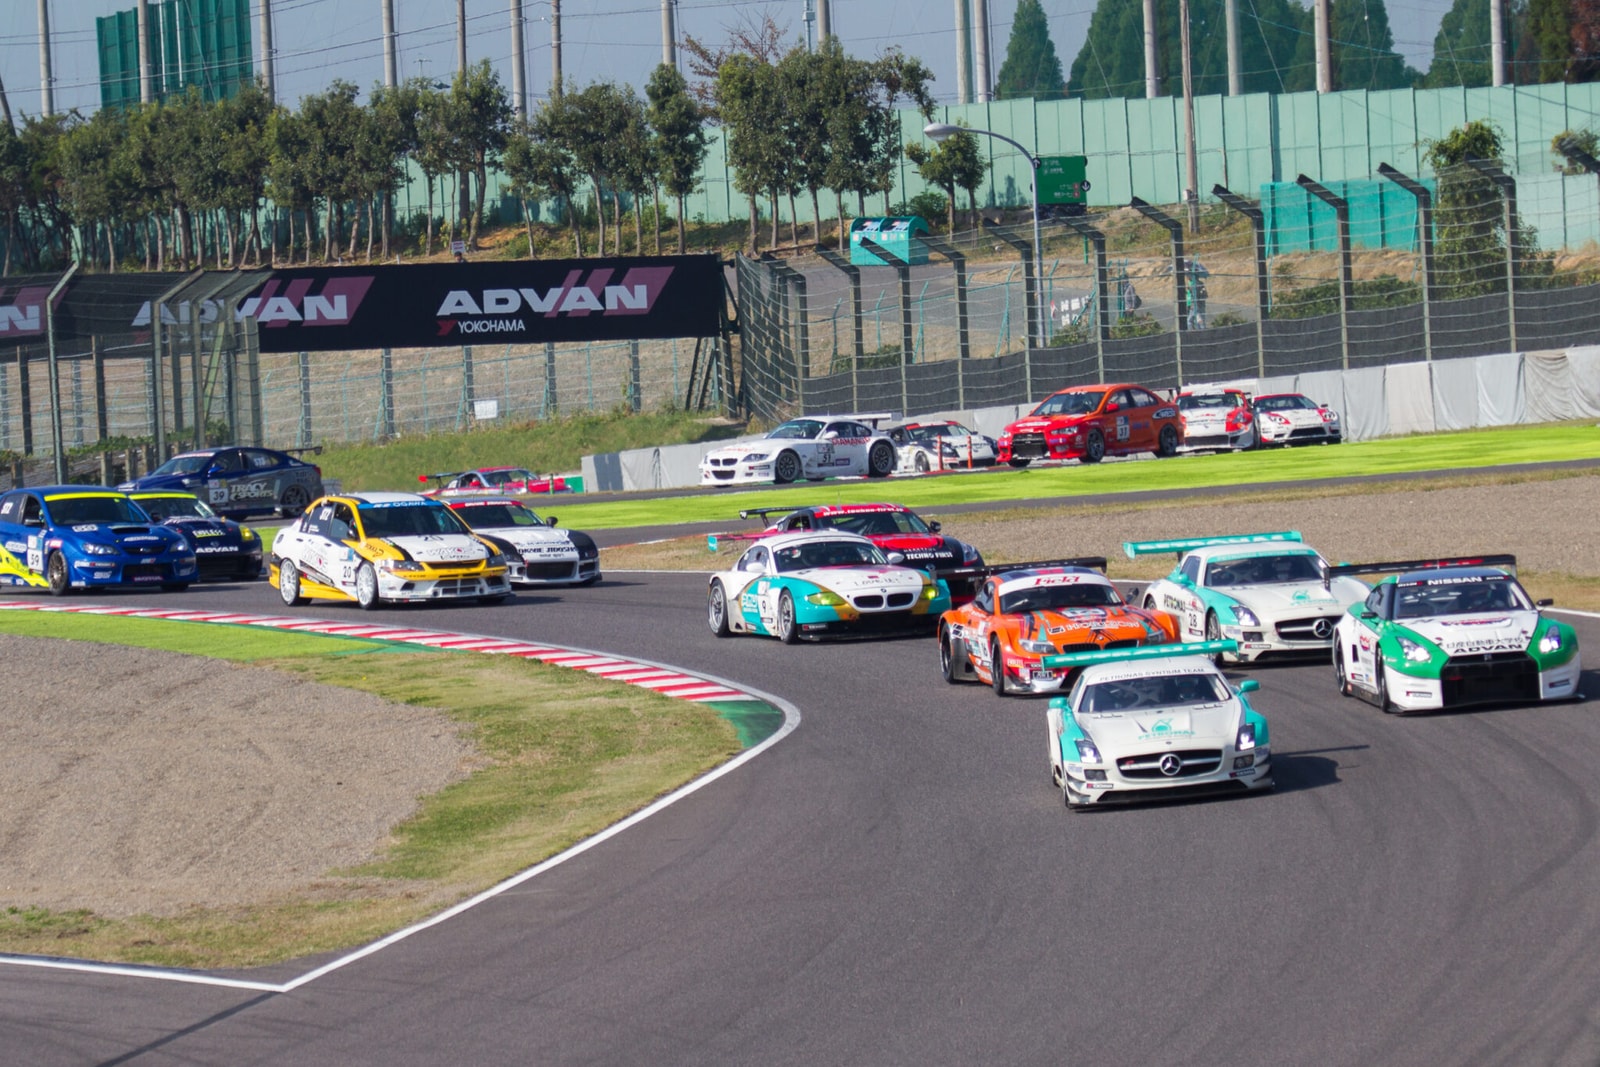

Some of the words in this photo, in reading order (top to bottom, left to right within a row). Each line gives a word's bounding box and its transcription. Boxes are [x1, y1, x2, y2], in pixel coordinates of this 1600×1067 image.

[436, 285, 648, 315] ADVAN
[457, 319, 526, 334] YOKOHAMA
[230, 483, 267, 492] TRACY
[213, 491, 225, 501] 39
[196, 546, 239, 554] ADVAN
[31, 554, 40, 567] 59
[906, 552, 934, 560] TECHNO
[935, 551, 953, 559] FIRST
[343, 566, 352, 578] 20
[1427, 576, 1482, 586] NISSAN
[1163, 594, 1186, 612] PETRONAS
[1188, 613, 1198, 628] 28
[1453, 644, 1522, 654] ADVAN
[1098, 672, 1144, 682] PETRONAS
